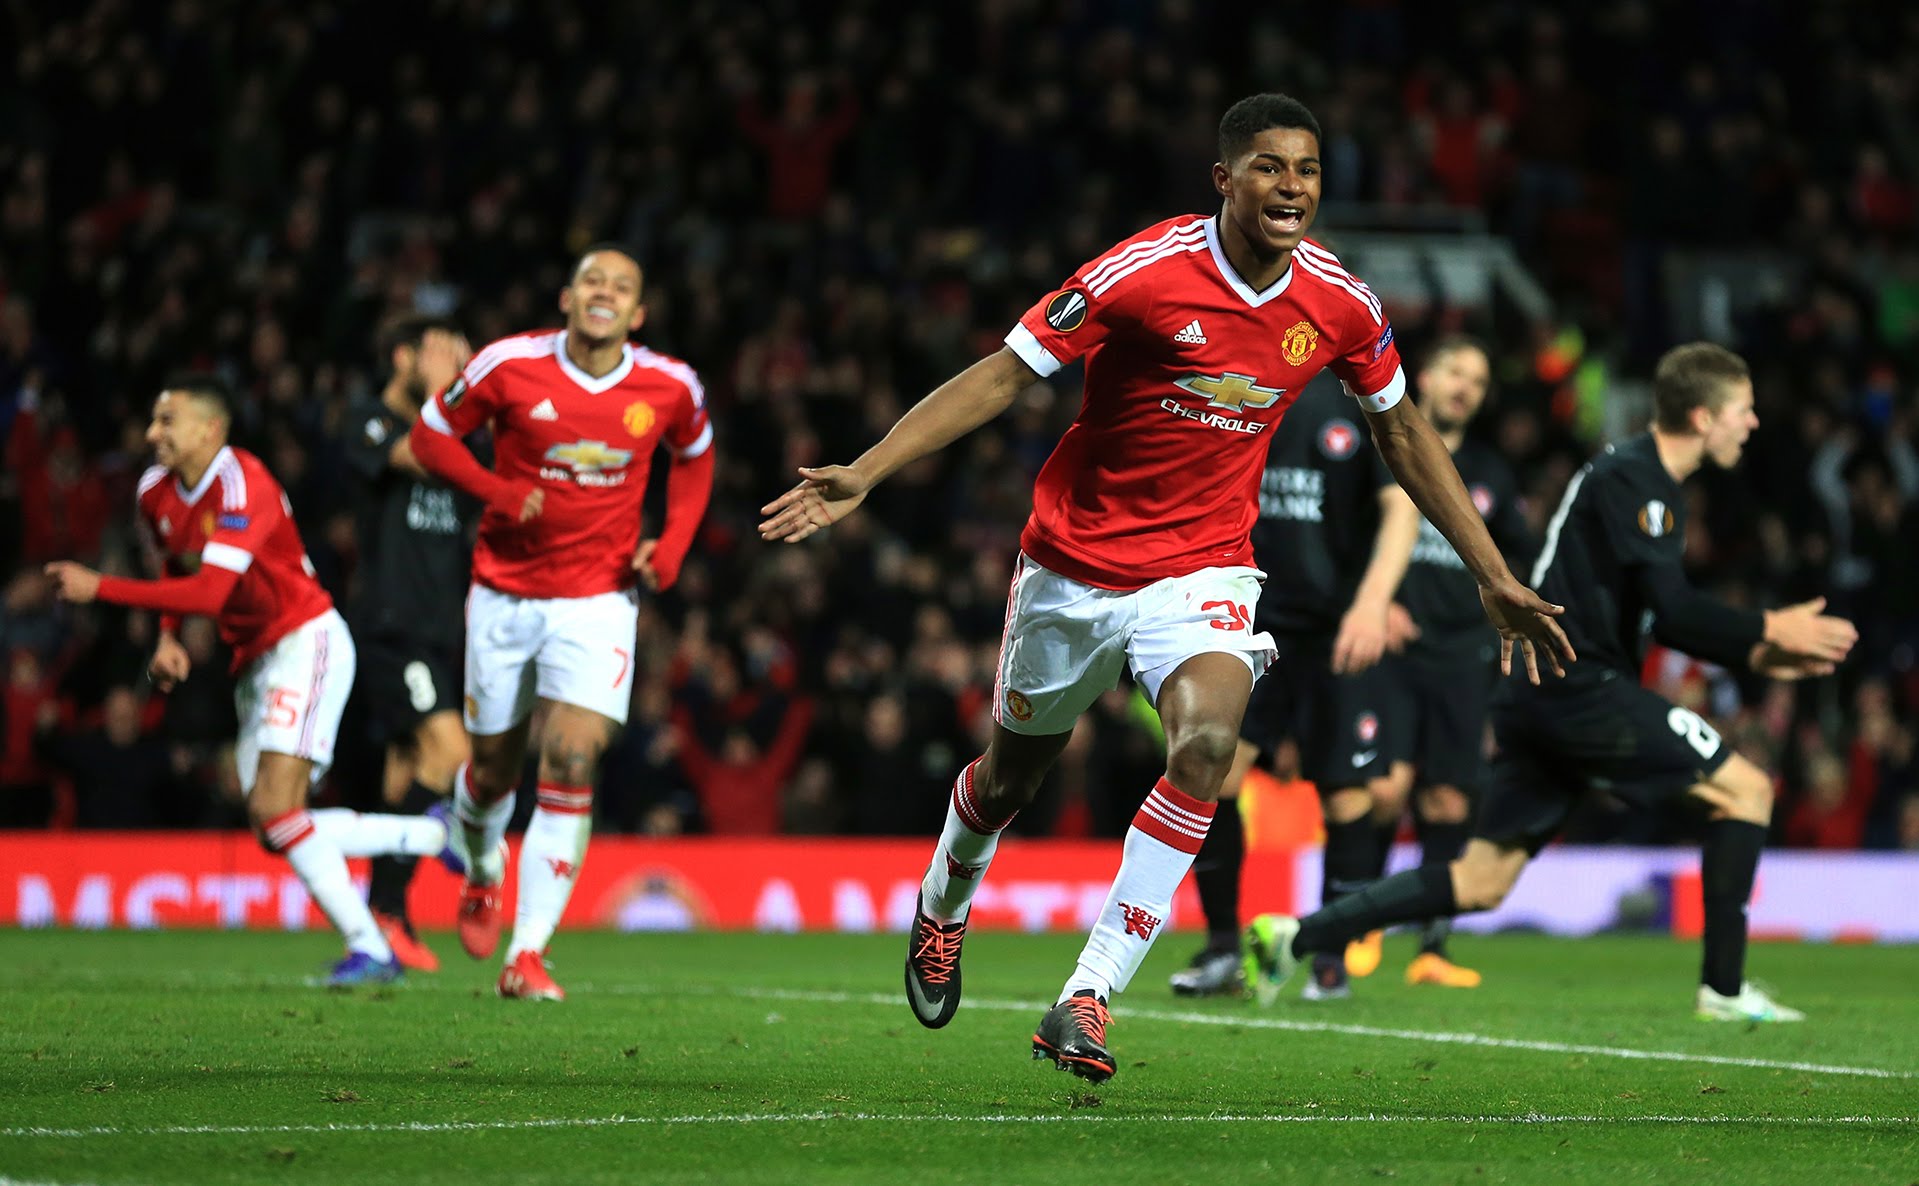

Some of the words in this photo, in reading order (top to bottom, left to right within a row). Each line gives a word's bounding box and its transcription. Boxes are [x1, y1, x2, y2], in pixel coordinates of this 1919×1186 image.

[1174, 333, 1208, 345] adidas
[1160, 398, 1268, 434] CHEVROLET
[612, 646, 629, 689] 7
